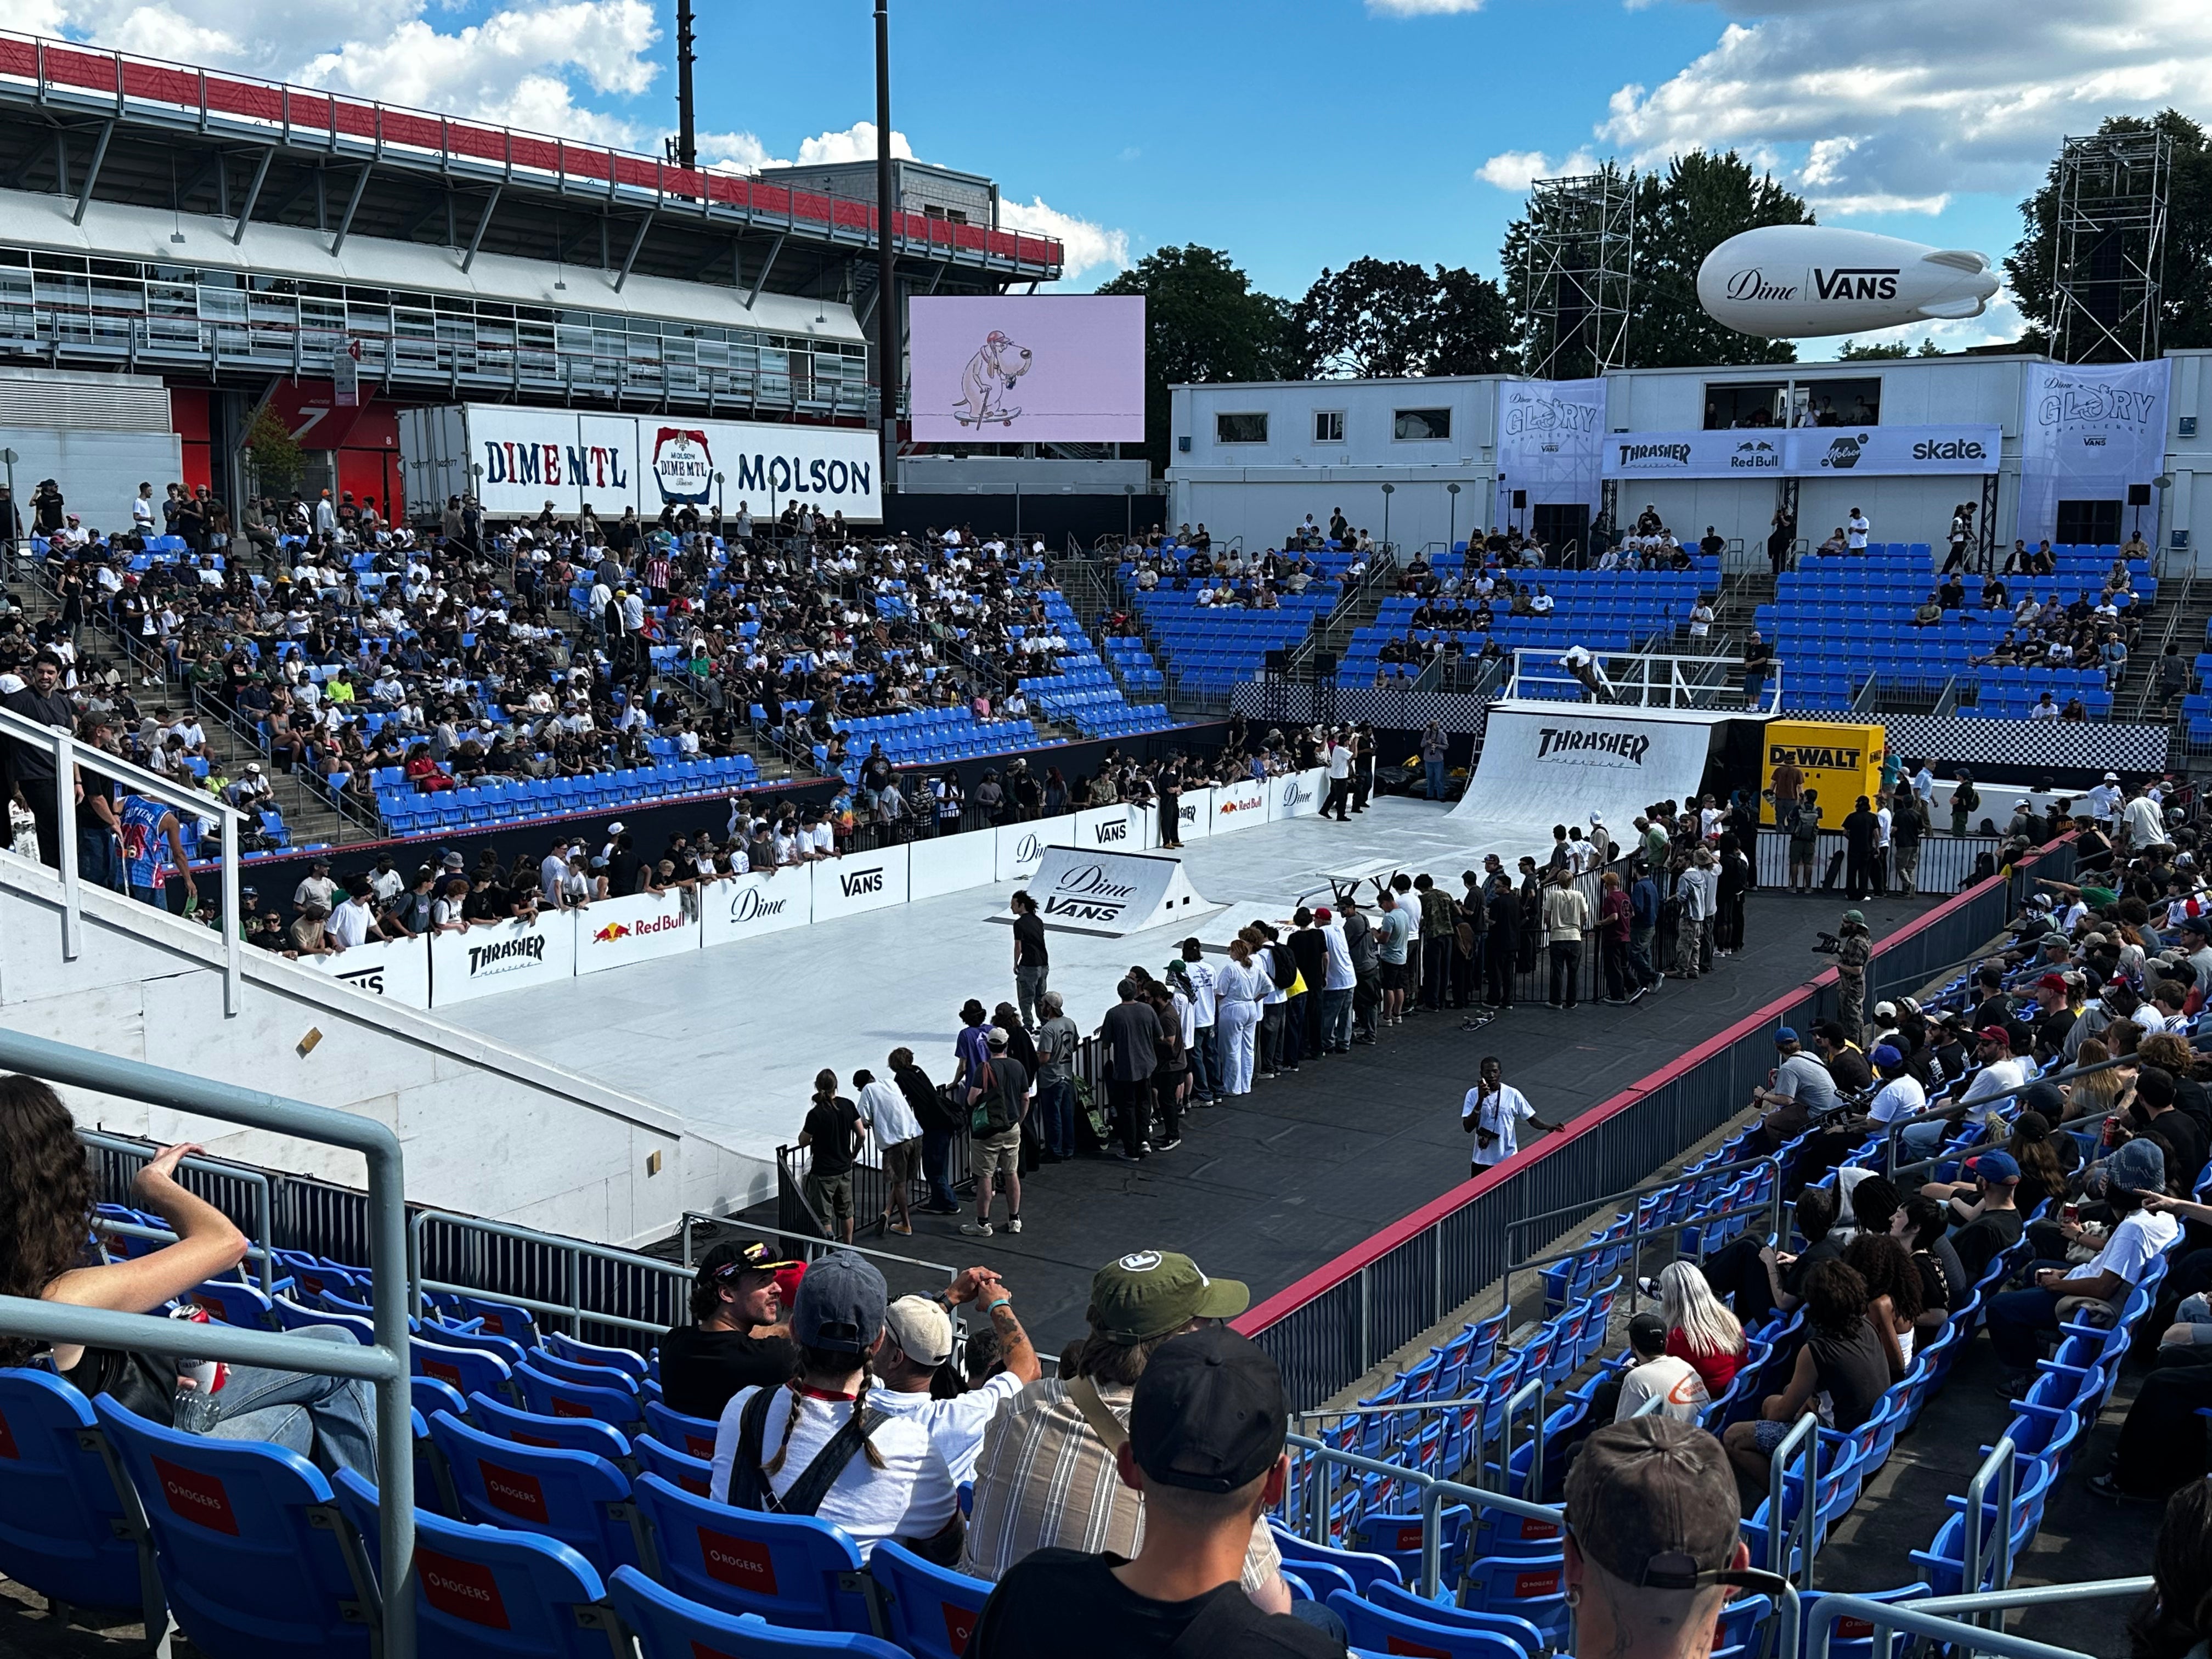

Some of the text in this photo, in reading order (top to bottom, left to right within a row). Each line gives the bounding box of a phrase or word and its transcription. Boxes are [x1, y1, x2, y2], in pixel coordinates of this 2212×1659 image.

[1726, 267, 1900, 301] Dime VANS
[2044, 377, 2073, 389] Dime
[1505, 398, 1597, 436] GLORY
[2038, 383, 2155, 426] GLORY
[2083, 437, 2107, 446] VANS
[485, 441, 627, 489] DIME MTL
[670, 452, 696, 460] MOLSON
[1620, 443, 1691, 466] THRASHER
[1731, 455, 1778, 467] Red Bull
[660, 460, 685, 476] DIME
[738, 454, 870, 495] MOLSON
[1537, 728, 1650, 766] THRASHER
[1239, 796, 1262, 810] Red Bull
[1284, 781, 1313, 808] Dime
[1095, 819, 1127, 844] VANS
[840, 867, 884, 898] VANS
[1056, 863, 1137, 898] Dime
[730, 884, 787, 924] Dime
[1043, 896, 1126, 922] VANS
[635, 911, 685, 935] Red Bull
[468, 934, 545, 977] THRASHER
[178, 1486, 222, 1510] ROGERS
[499, 1484, 536, 1503] ROGERS
[721, 1553, 764, 1573] ROGERS
[441, 1577, 490, 1602] ROGERS
[1528, 1579, 1554, 1588] ROGERS
